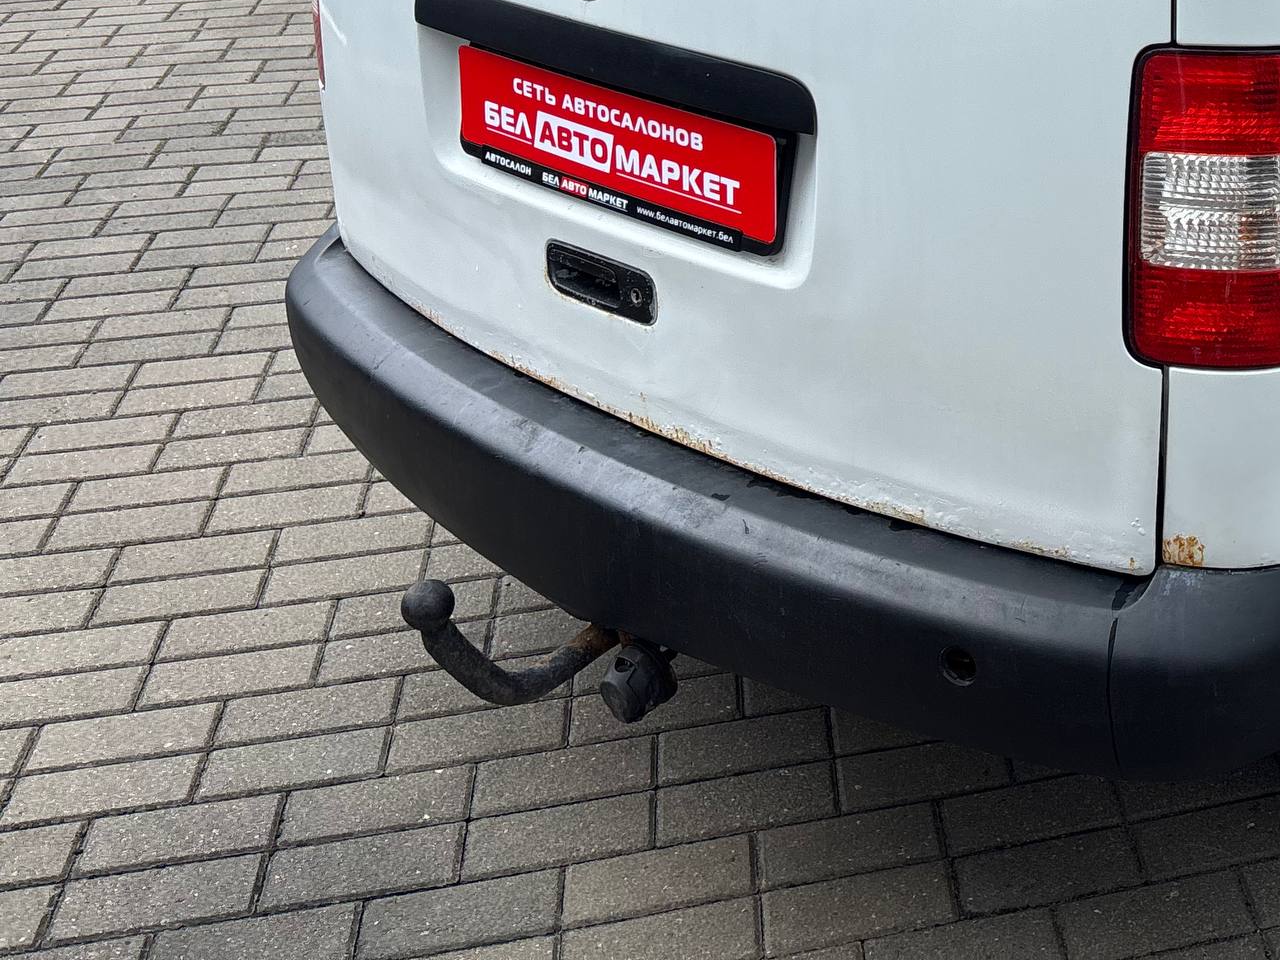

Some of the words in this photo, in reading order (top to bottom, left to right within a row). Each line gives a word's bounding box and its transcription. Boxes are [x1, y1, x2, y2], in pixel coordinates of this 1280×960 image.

[513, 77, 556, 105] СЕТЬ
[562, 94, 704, 151] АВТОСАЛОНОВ
[484, 151, 532, 176] АВТОСАЛОН
[542, 171, 559, 187] БЕЛ
[561, 177, 587, 196] АВТО
[588, 189, 628, 210] МАРКЕТ
[636, 205, 734, 244] www.белавтомаркет.бел
